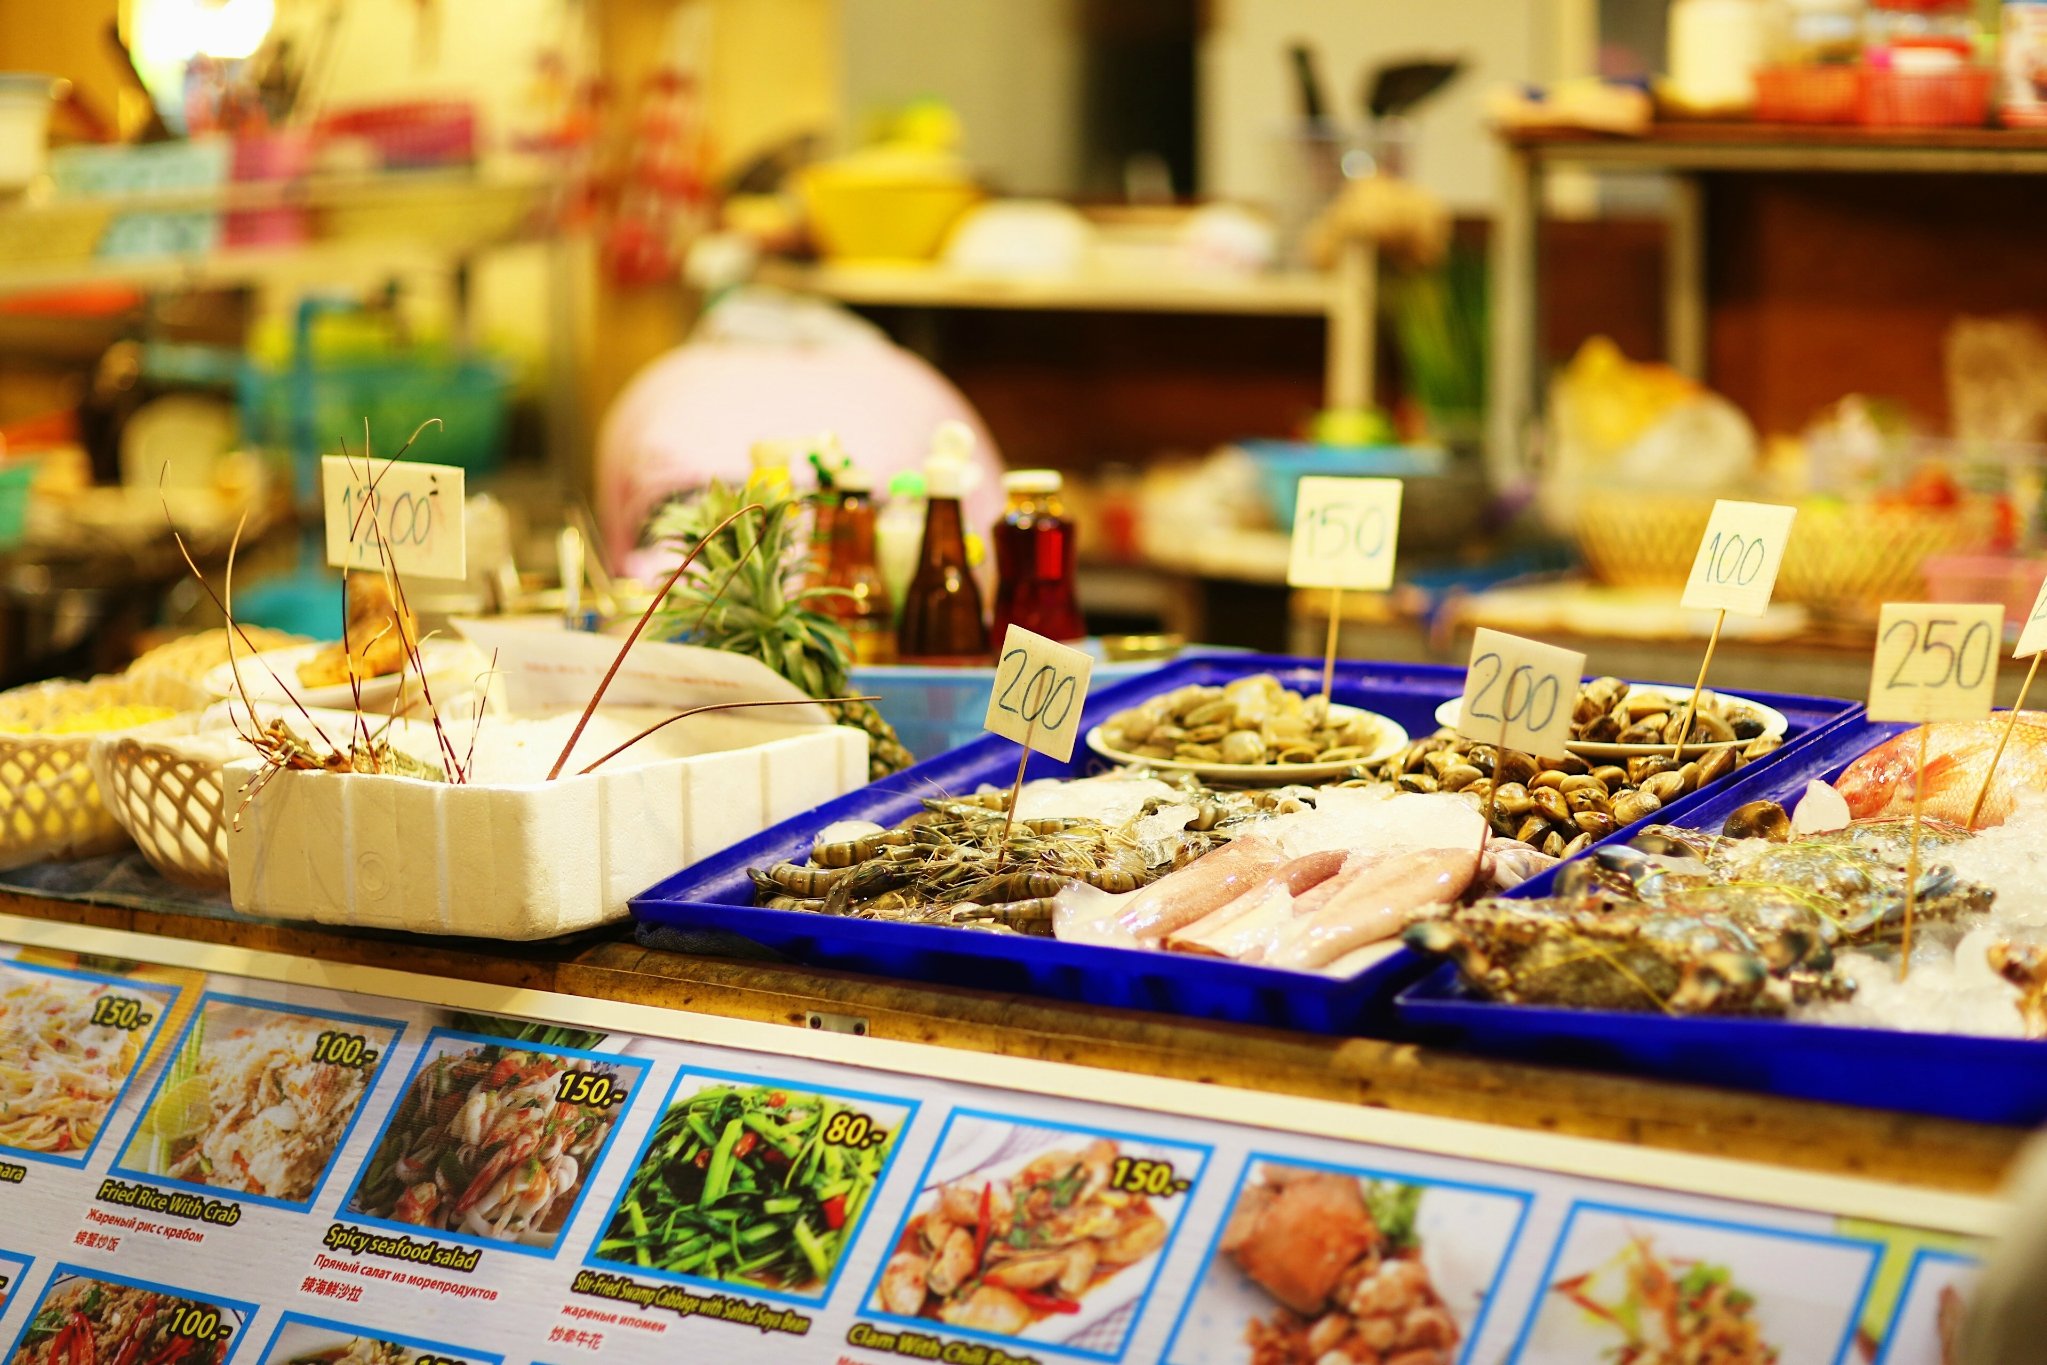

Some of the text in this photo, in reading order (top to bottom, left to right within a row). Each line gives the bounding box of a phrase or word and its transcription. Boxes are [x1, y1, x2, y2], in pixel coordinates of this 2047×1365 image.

[1306, 502, 1387, 560] 150
[1706, 532, 1765, 586] 100
[1882, 619, 1992, 689] 250
[998, 648, 1076, 730] 200
[1470, 652, 1559, 732] 200
[313, 1032, 376, 1066] 100.-
[557, 1073, 626, 1107] 150.-
[825, 1113, 887, 1148] 80.-
[98, 1181, 241, 1224] Fried Rice With Crab
[85, 1208, 136, 1230] Жареный
[135, 1220, 156, 1234] рис
[163, 1224, 204, 1244] крабом
[325, 1225, 479, 1271] Spicy seafood salad
[313, 1253, 499, 1302] Пряный салат из морепродуктов
[169, 1306, 231, 1342] 100.-
[561, 1304, 668, 1334] жареные ипомеи
[573, 1272, 811, 1334] Stir-Fried Swamp Cabbage with Salted Soya Bean
[848, 1324, 896, 1350] Clam
[896, 1333, 942, 1358] With
